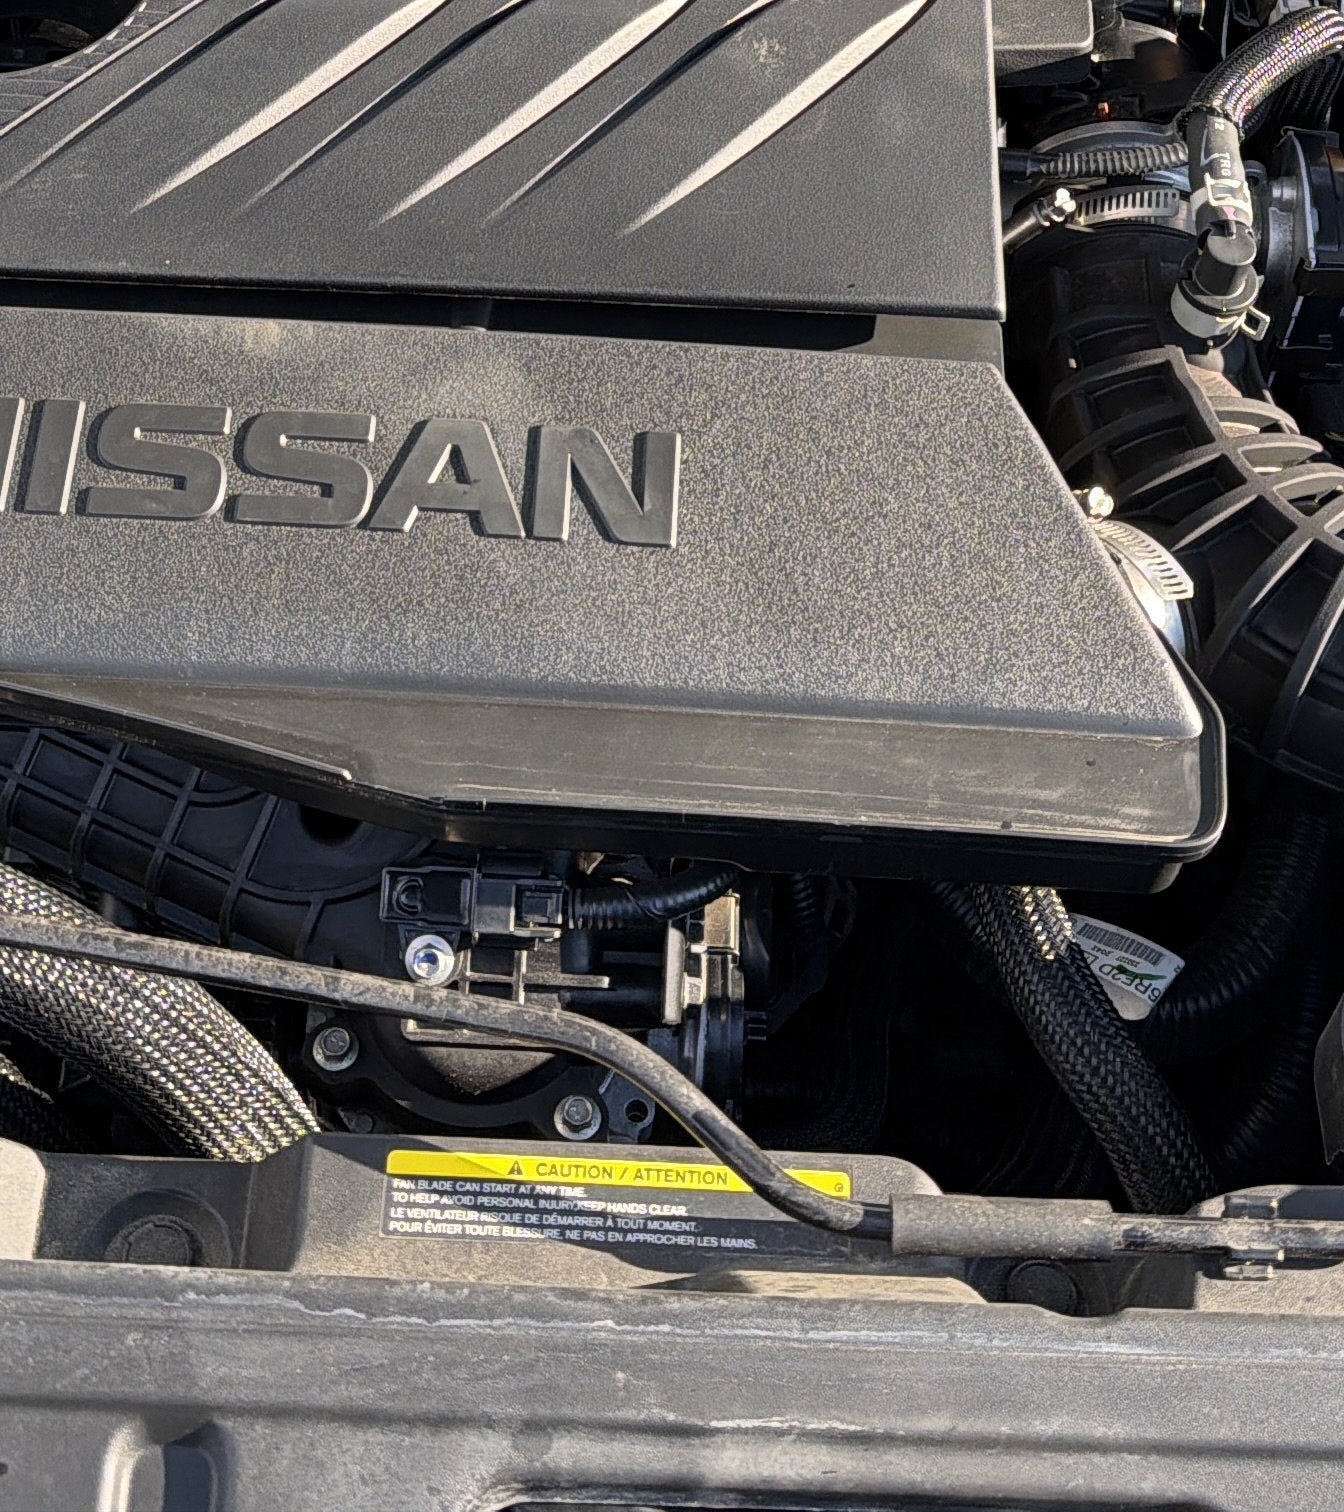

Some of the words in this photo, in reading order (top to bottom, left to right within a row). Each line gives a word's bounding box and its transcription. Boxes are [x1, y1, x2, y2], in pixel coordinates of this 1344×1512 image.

[535, 1162, 613, 1179] CAUTION
[633, 1168, 728, 1186] ATTENTION
[392, 1178, 416, 1190] FAN
[418, 1180, 454, 1190] BLADE
[456, 1181, 481, 1192] CAN
[482, 1182, 516, 1193] START
[518, 1184, 532, 1194] AT
[533, 1185, 558, 1195] ANY
[392, 1192, 409, 1202] TO
[410, 1193, 439, 1204] HELP
[440, 1194, 475, 1206] AVOID
[477, 1196, 536, 1208] PERSONAL
[607, 1201, 648, 1215] HANDS
[390, 1207, 406, 1218] LE
[406, 1208, 479, 1221] VENTILATEUR
[480, 1210, 523, 1223] RISQUE
[524, 1213, 541, 1224] DE
[542, 1212, 603, 1228] DÉMARRER
[616, 1219, 645, 1230] TOUT
[389, 1220, 422, 1233] POUR
[424, 1220, 463, 1235] ÉVITER
[464, 1224, 501, 1236] TOUTE
[565, 1229, 581, 1240] NE
[583, 1230, 606, 1242] PAS
[608, 1232, 624, 1242] EN
[625, 1232, 695, 1246] APPROCHER
[697, 1236, 719, 1247] LES
